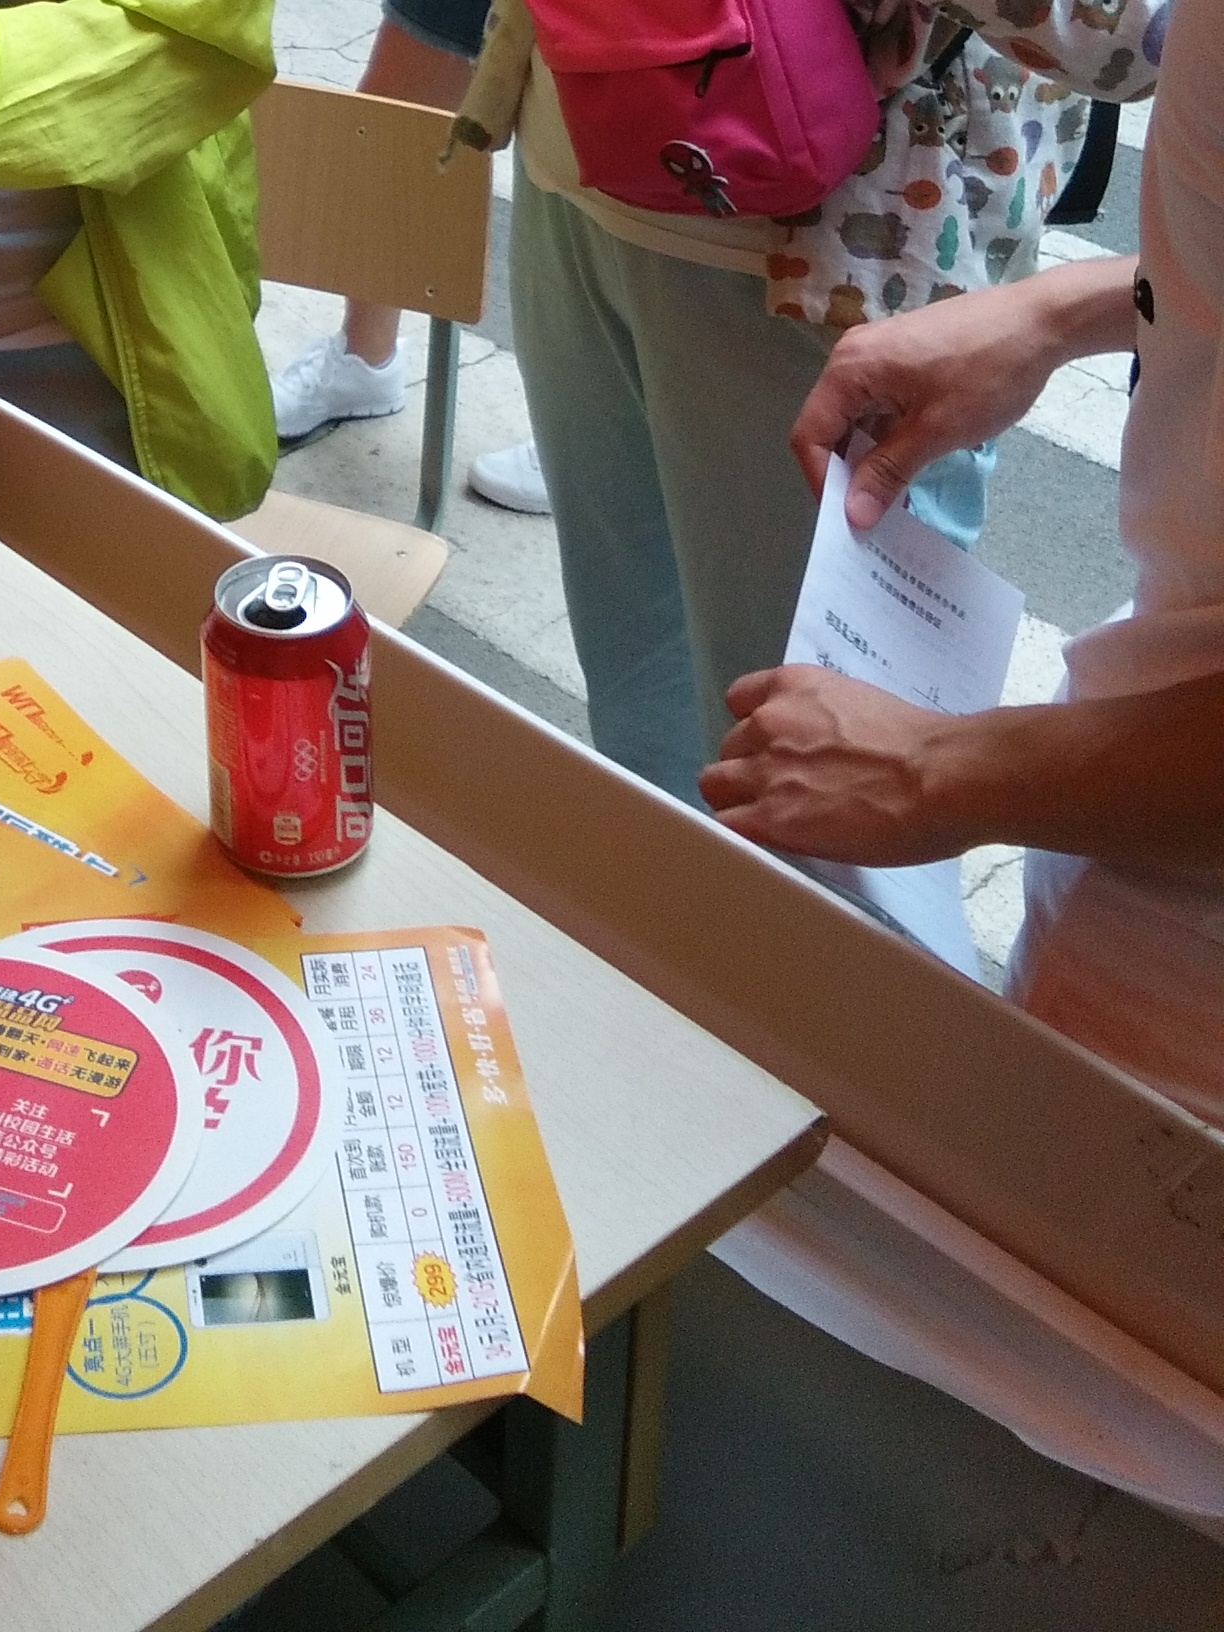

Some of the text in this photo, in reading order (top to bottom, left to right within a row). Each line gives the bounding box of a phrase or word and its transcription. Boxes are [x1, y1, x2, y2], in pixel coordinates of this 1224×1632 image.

[309, 957, 332, 996] 月实际
[331, 962, 351, 988] 消费
[362, 964, 376, 981] 24
[338, 1005, 359, 1032] 月租
[370, 1007, 386, 1026] 36
[188, 1027, 263, 1089] 你
[377, 1046, 394, 1064] 12
[12, 1098, 49, 1120] 关注
[388, 1093, 404, 1111] 12
[397, 1143, 418, 1170] 150
[423, 1263, 448, 1299] 299
[437, 1324, 466, 1377] 金元宝
